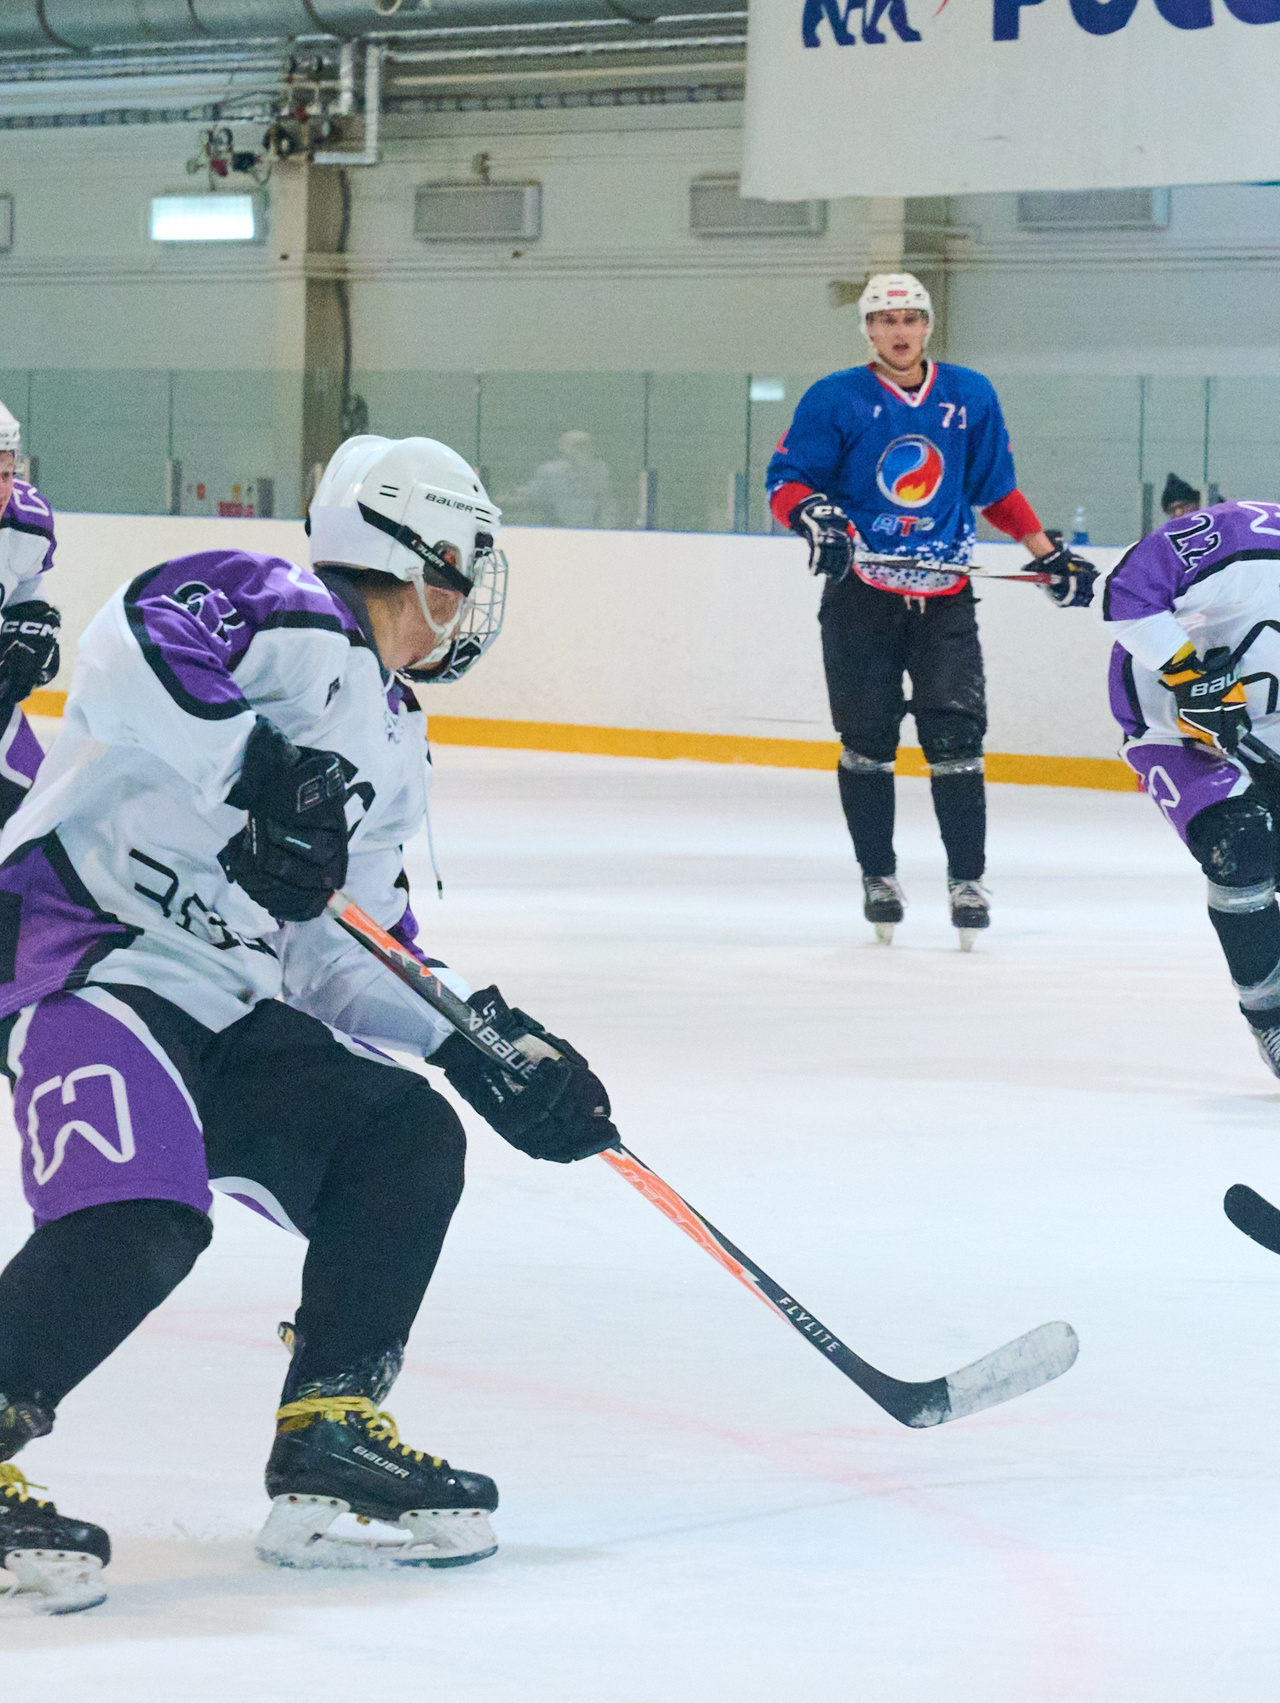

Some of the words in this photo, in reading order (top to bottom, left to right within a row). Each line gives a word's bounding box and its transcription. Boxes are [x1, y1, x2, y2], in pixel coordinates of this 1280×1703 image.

[938, 402, 967, 430] 71
[1164, 512, 1222, 574] 22
[2, 620, 60, 638] CCM
[779, 1296, 842, 1353] FLYLITE
